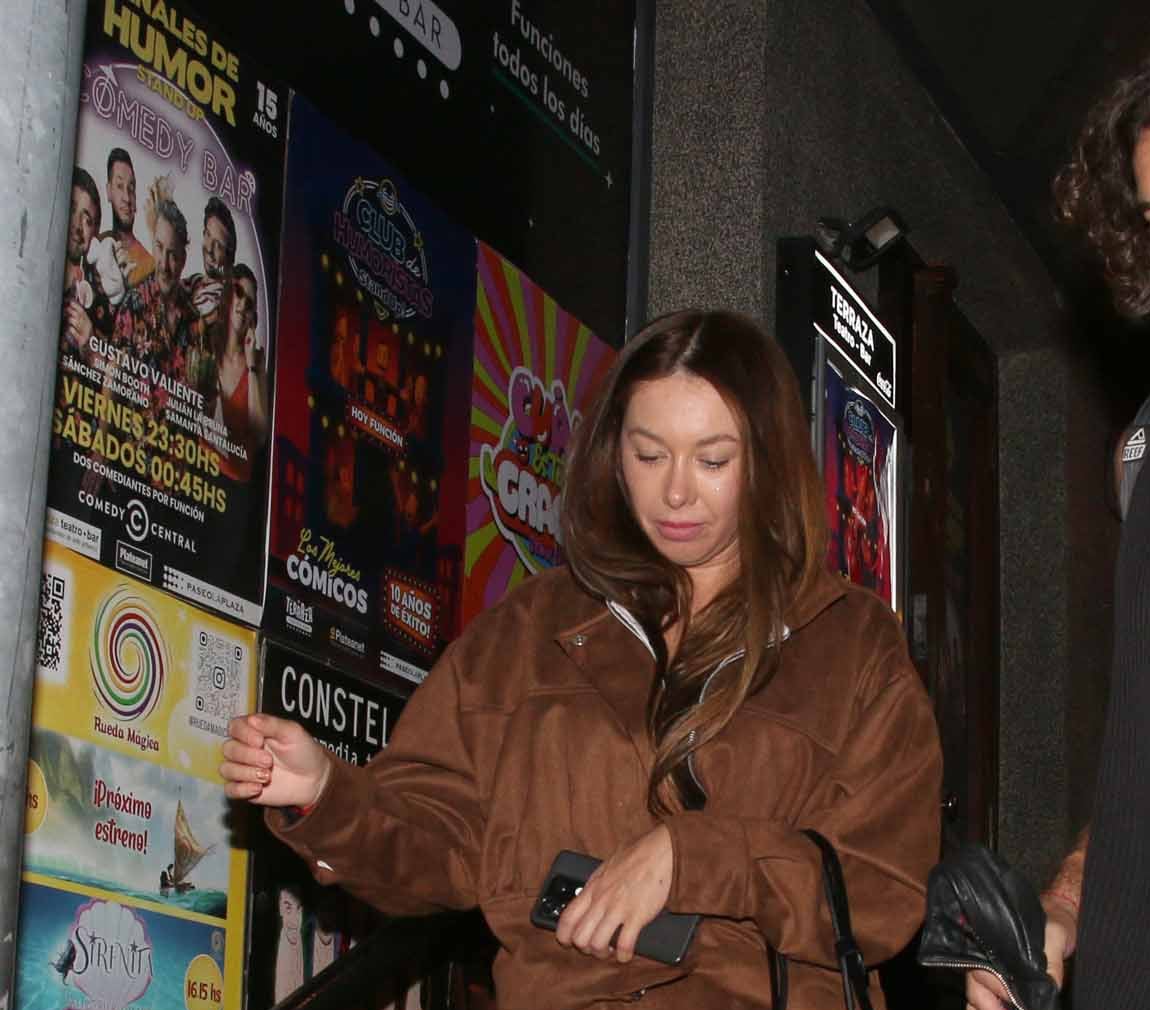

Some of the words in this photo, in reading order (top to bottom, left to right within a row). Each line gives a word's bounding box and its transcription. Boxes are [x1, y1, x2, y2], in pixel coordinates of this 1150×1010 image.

[103, 0, 237, 127] HUMOR
[210, 39, 240, 83] DE
[492, 31, 539, 96] todos
[543, 73, 566, 121] los
[511, 0, 590, 98] Funciones
[252, 110, 278, 139] AÑOS
[256, 80, 278, 121] 15
[81, 64, 194, 173] OMEDY
[203, 149, 255, 215] BAR
[356, 198, 407, 265] CLUB
[830, 285, 874, 352] TERRAZA
[89, 335, 149, 379] GUSTAVO
[151, 368, 206, 411] VALIENTE
[121, 371, 151, 396] BOOTH
[62, 375, 144, 442] VIERNES
[147, 420, 221, 478] 23:30HS
[351, 404, 369, 425] HOY
[369, 417, 403, 448] FUNCIÓN
[72, 451, 92, 471] DOS
[92, 461, 152, 499] COMEDIANTES
[152, 488, 169, 507] POR
[169, 497, 205, 524] FUNCIÓN
[150, 455, 227, 513] 00:45HS
[78, 490, 126, 521] COMEDY
[150, 522, 198, 554] CENTRAL
[390, 583, 401, 602] 10
[401, 590, 432, 620] AÑOS
[94, 715, 124, 739] Rueda
[95, 818, 148, 855] estreno!
[210, 983, 222, 1003] hs
